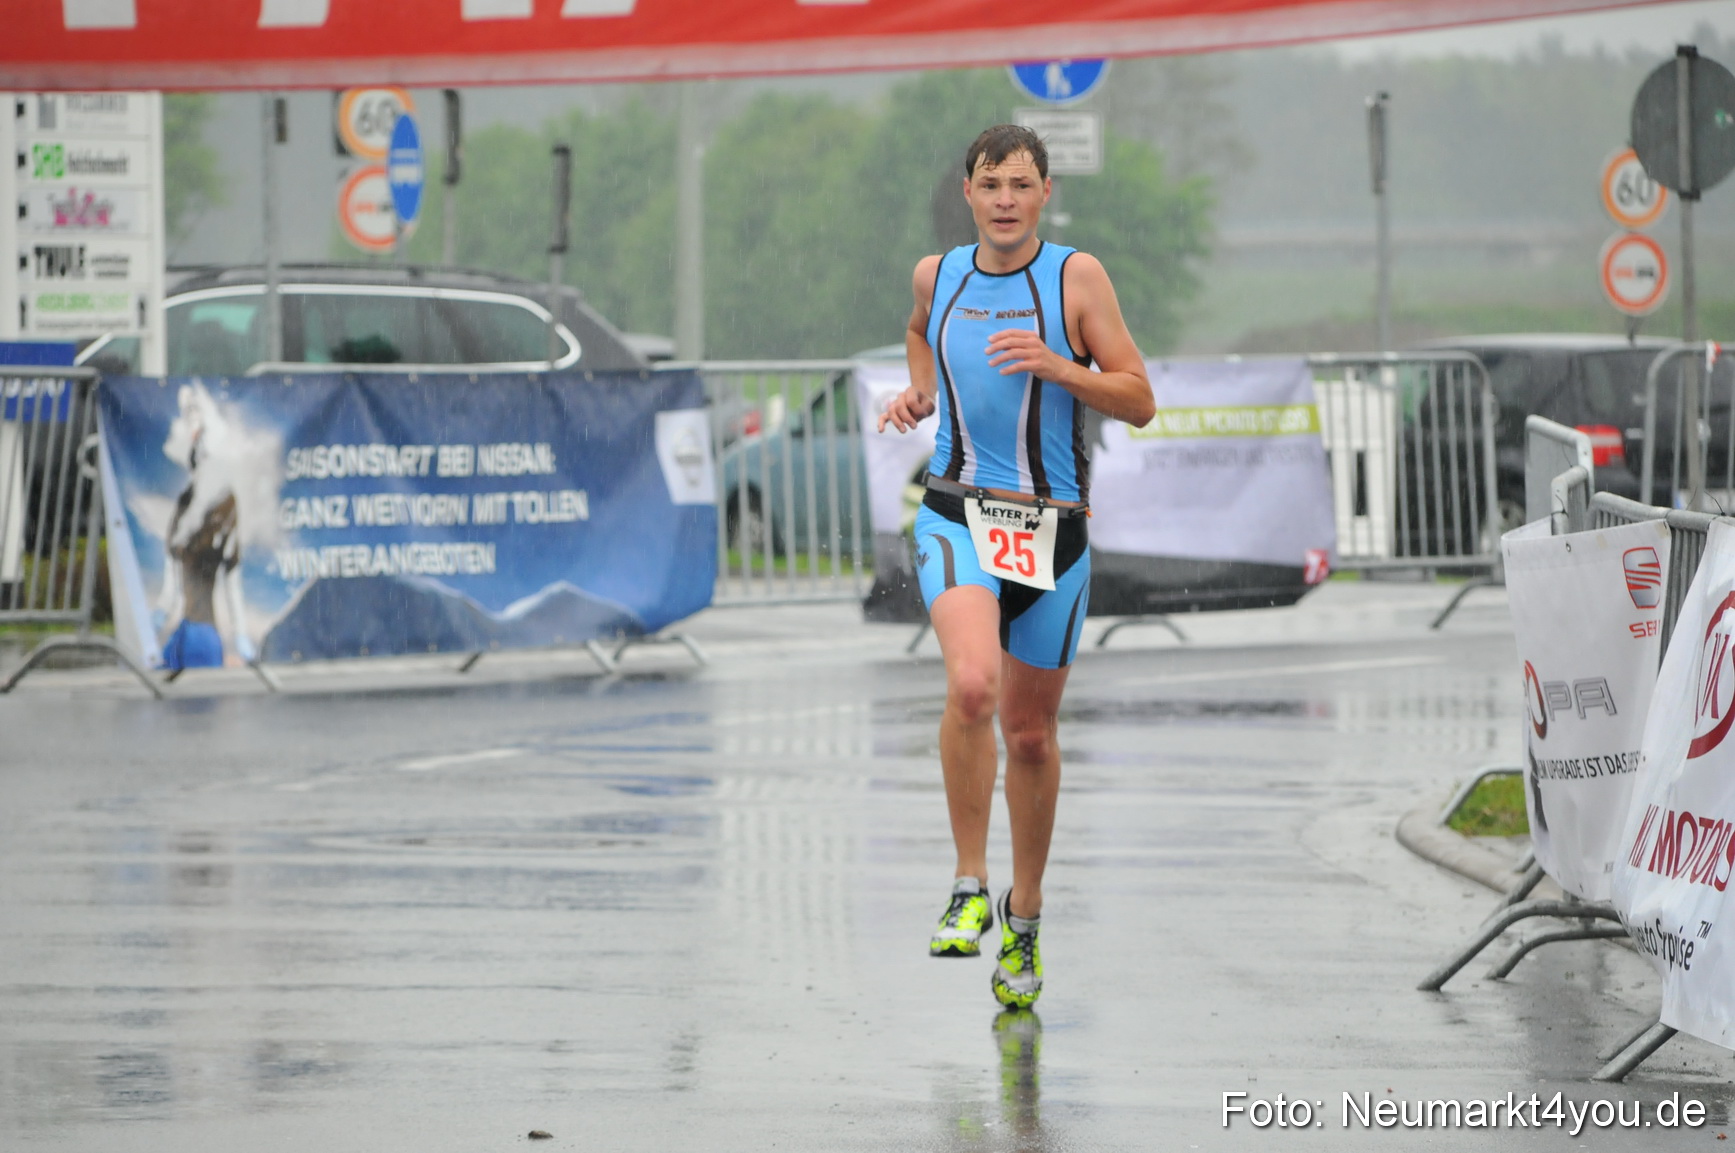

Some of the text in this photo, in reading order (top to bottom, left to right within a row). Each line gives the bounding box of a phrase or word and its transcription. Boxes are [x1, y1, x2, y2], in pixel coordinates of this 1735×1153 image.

[1615, 168, 1655, 207] 60
[437, 444, 474, 477] BEI
[280, 495, 349, 530] GANZ
[472, 493, 507, 525] MIT
[508, 490, 589, 523] TOLLEN
[980, 507, 1022, 519] MEYER
[981, 517, 1022, 527] WERBUNG
[276, 543, 497, 579] WINTERANGEBOTEN
[989, 528, 1036, 577] 25
[1547, 758, 1584, 780] UPGRADE
[1584, 756, 1604, 778] IST
[1604, 753, 1627, 775] DAS
